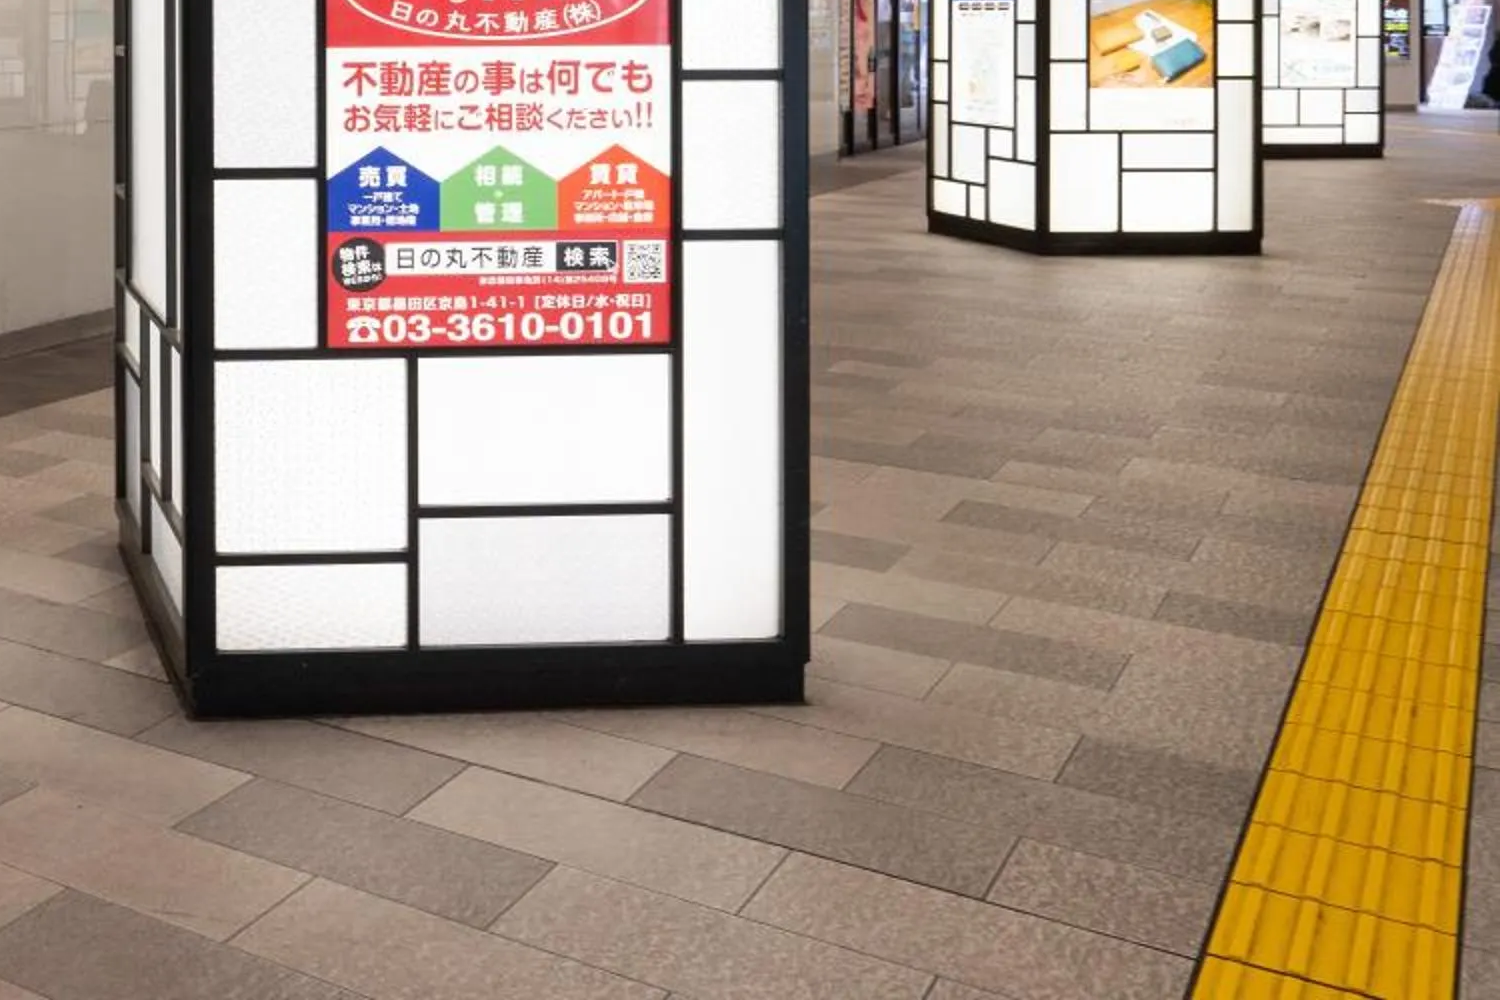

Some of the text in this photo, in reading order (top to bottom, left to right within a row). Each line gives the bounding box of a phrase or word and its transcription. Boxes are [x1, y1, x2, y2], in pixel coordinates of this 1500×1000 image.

[342, 60, 652, 96] 不動産の事は何でも
[396, 245, 611, 270] 日の丸不動産 検索
[383, 311, 653, 341] 03-3610-0101
